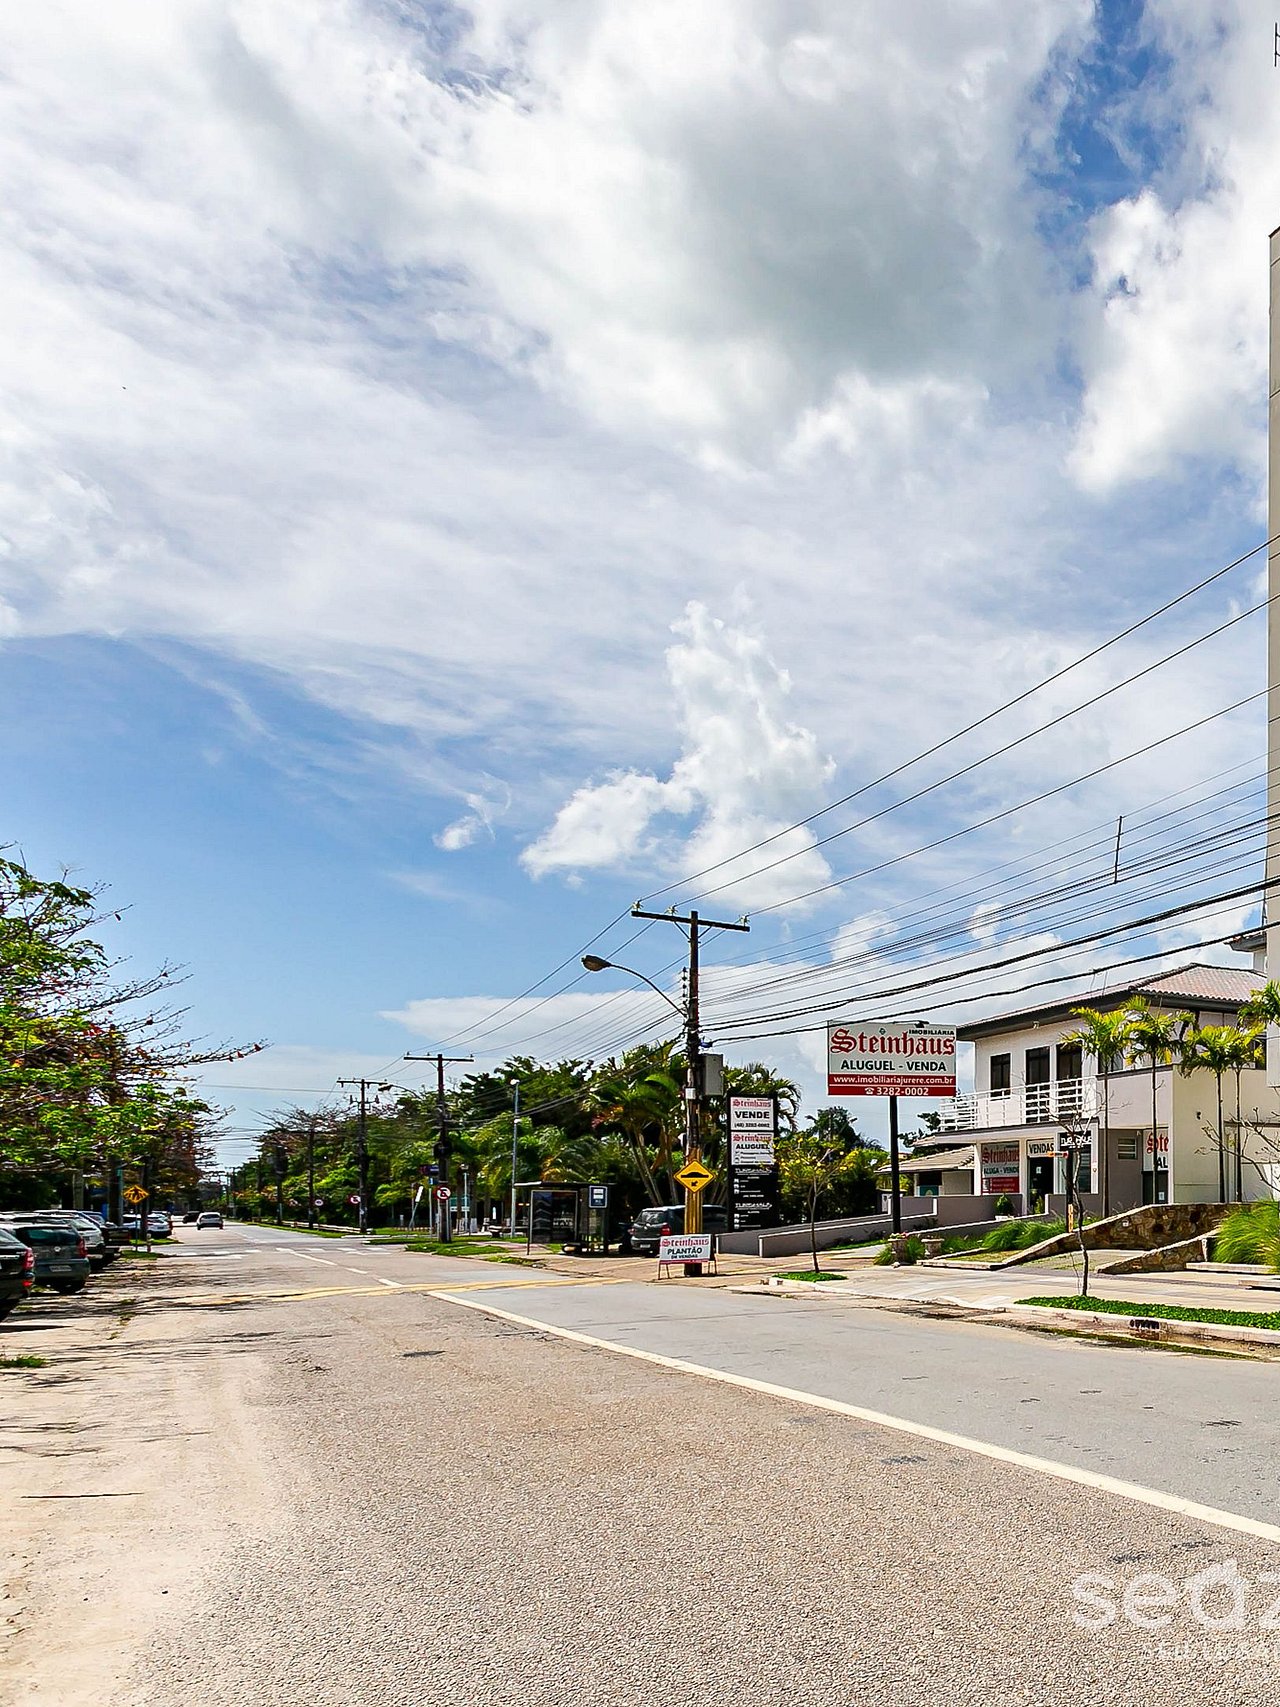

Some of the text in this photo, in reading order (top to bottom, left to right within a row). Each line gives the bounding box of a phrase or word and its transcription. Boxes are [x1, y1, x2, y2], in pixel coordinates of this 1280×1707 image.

[830, 1028, 956, 1059] Steinhaus
[840, 1059, 896, 1072] ALUGUEL
[906, 1061, 947, 1072] VENDA
[833, 1076, 953, 1085] www.imobiliariajurere.com.br
[876, 1087, 929, 1096] 3282-0002
[734, 1111, 770, 1119] VENDE
[1028, 1143, 1055, 1154] VENDAS
[667, 1246, 703, 1255] PLANTÃO
